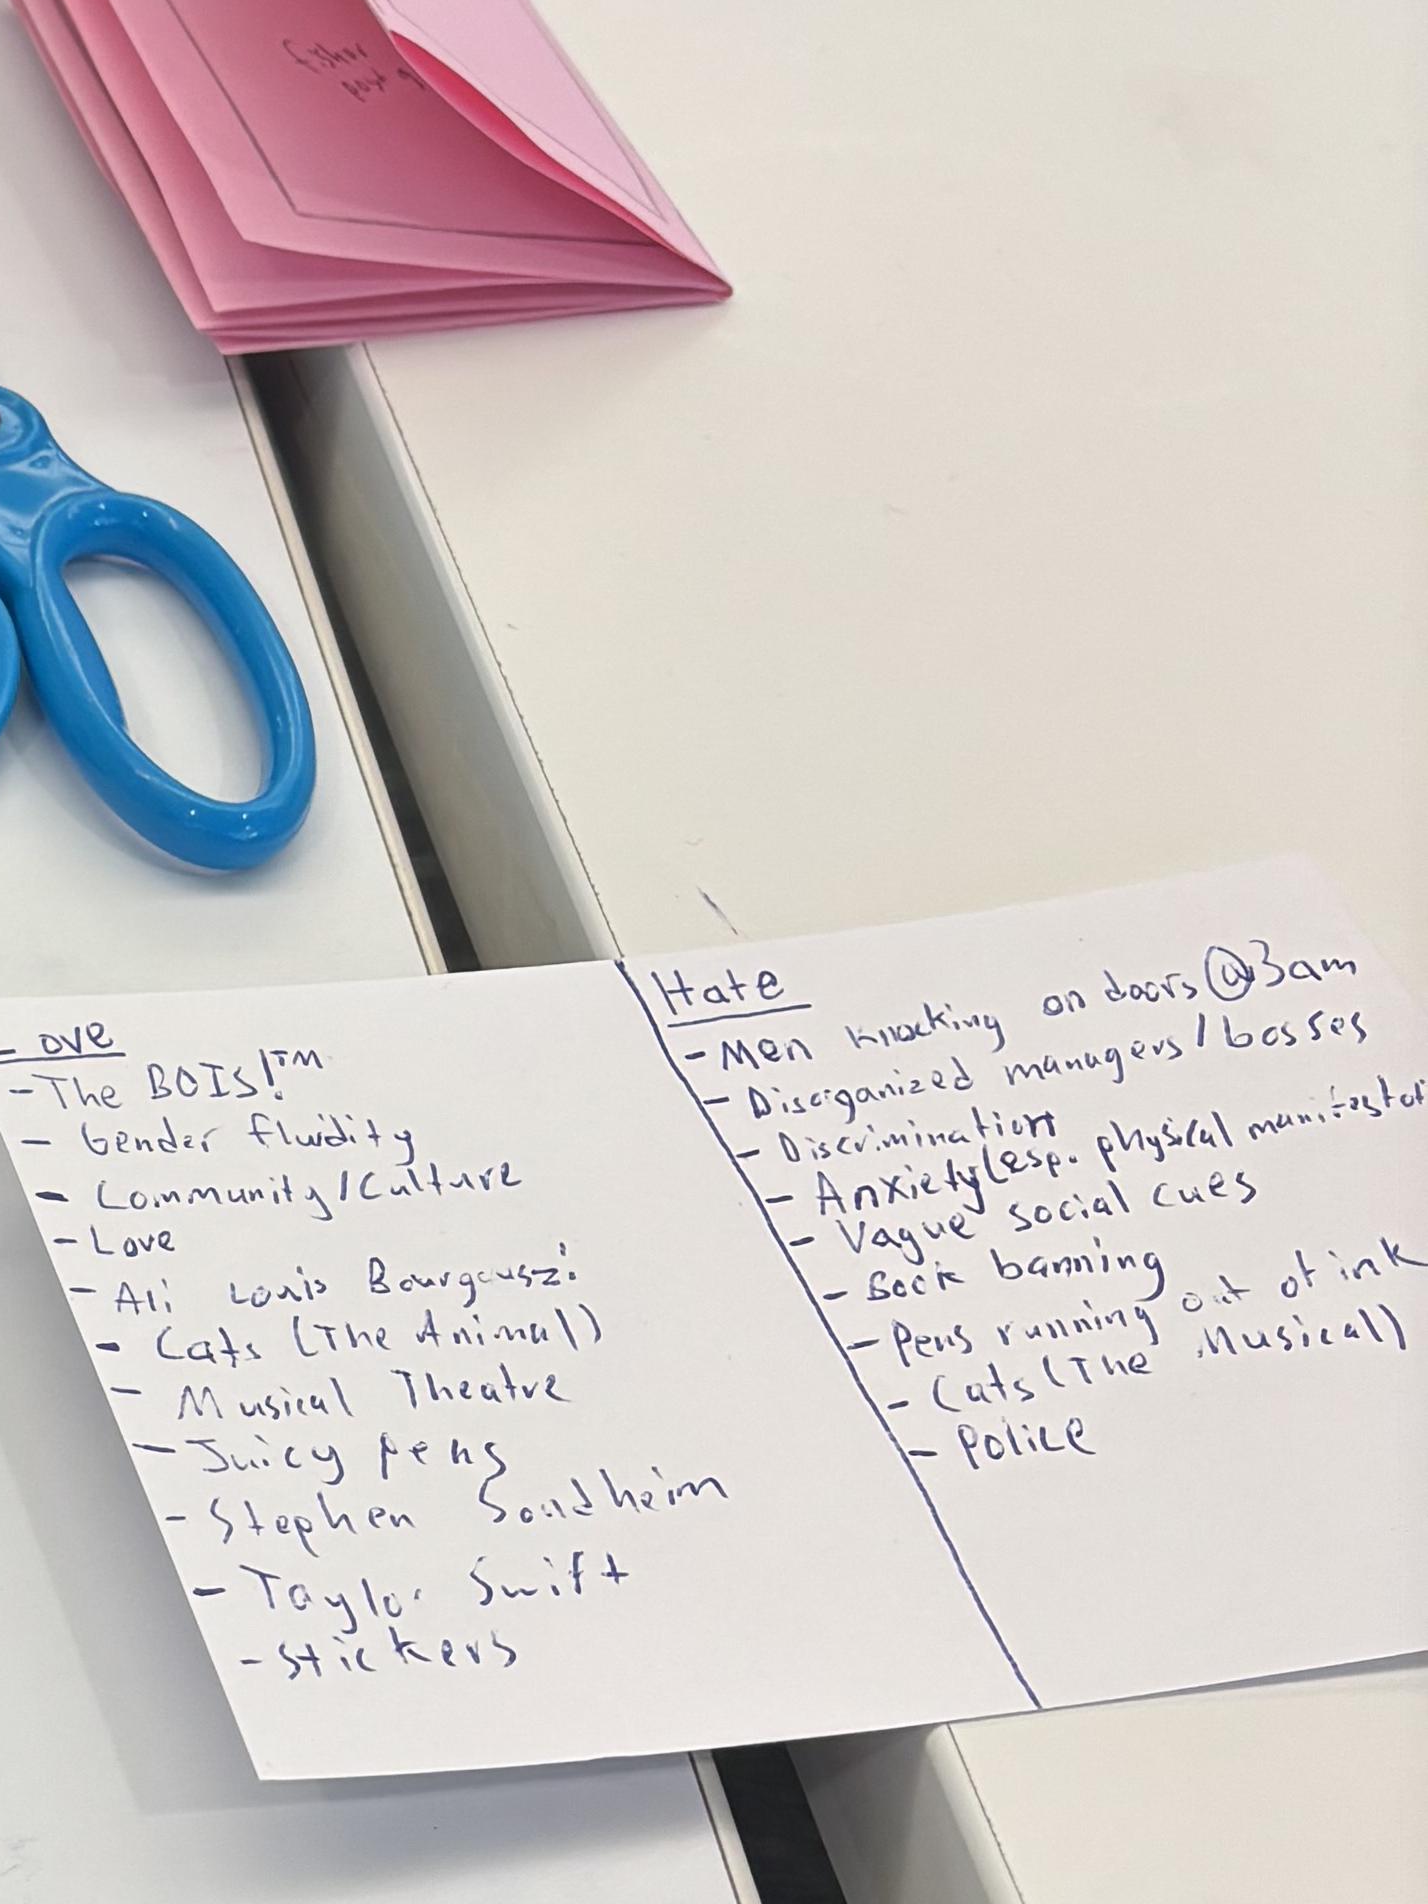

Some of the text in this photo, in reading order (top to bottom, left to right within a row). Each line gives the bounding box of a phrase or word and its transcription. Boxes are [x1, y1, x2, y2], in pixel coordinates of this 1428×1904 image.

[650, 965, 788, 1017] Hate
[722, 1039, 813, 1071] Men
[845, 1003, 1005, 1053] knocking
[1043, 990, 1086, 1016] on
[1104, 970, 1197, 1002] doors
[79, 1113, 417, 1165] Gender fluidity
[776, 1109, 1058, 1167] Discrimination
[1094, 1116, 1236, 1172] physical
[88, 1225, 177, 1256] Love
[832, 1167, 1260, 1268] Vague social cues
[865, 1245, 1167, 1306] Book banning
[997, 1303, 1161, 1349] running
[1180, 1284, 1251, 1315] out
[1326, 1236, 1428, 1285] ink
[157, 1303, 604, 1369] Cats (The Animal)
[930, 1365, 1037, 1414] Cats
[1197, 1303, 1410, 1361] Musical)
[178, 1366, 574, 1422] Musical Theatre
[188, 1434, 347, 1486] Juicy
[209, 1464, 730, 1560] Stephen Sondheim
[240, 1549, 631, 1635] Taylor Swift
